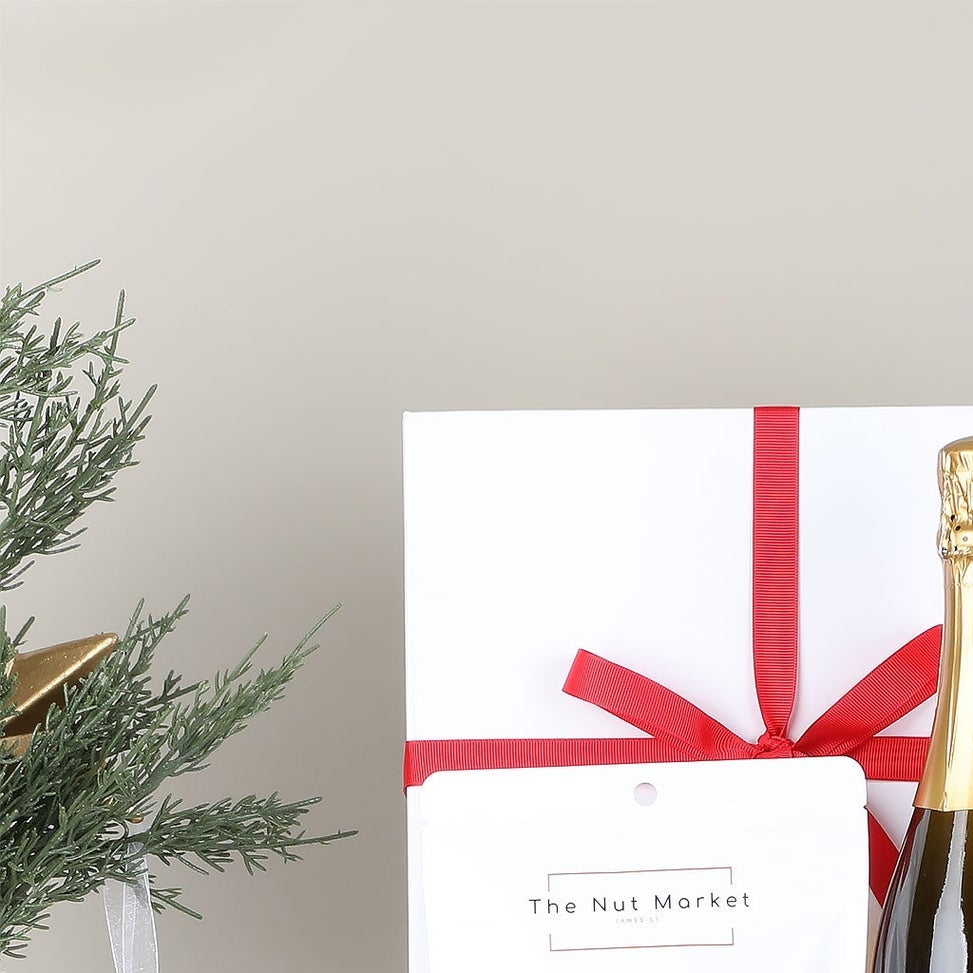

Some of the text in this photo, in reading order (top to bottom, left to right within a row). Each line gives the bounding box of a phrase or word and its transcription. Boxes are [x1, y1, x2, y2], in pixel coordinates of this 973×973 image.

[529, 892, 750, 914] The Nut Market
